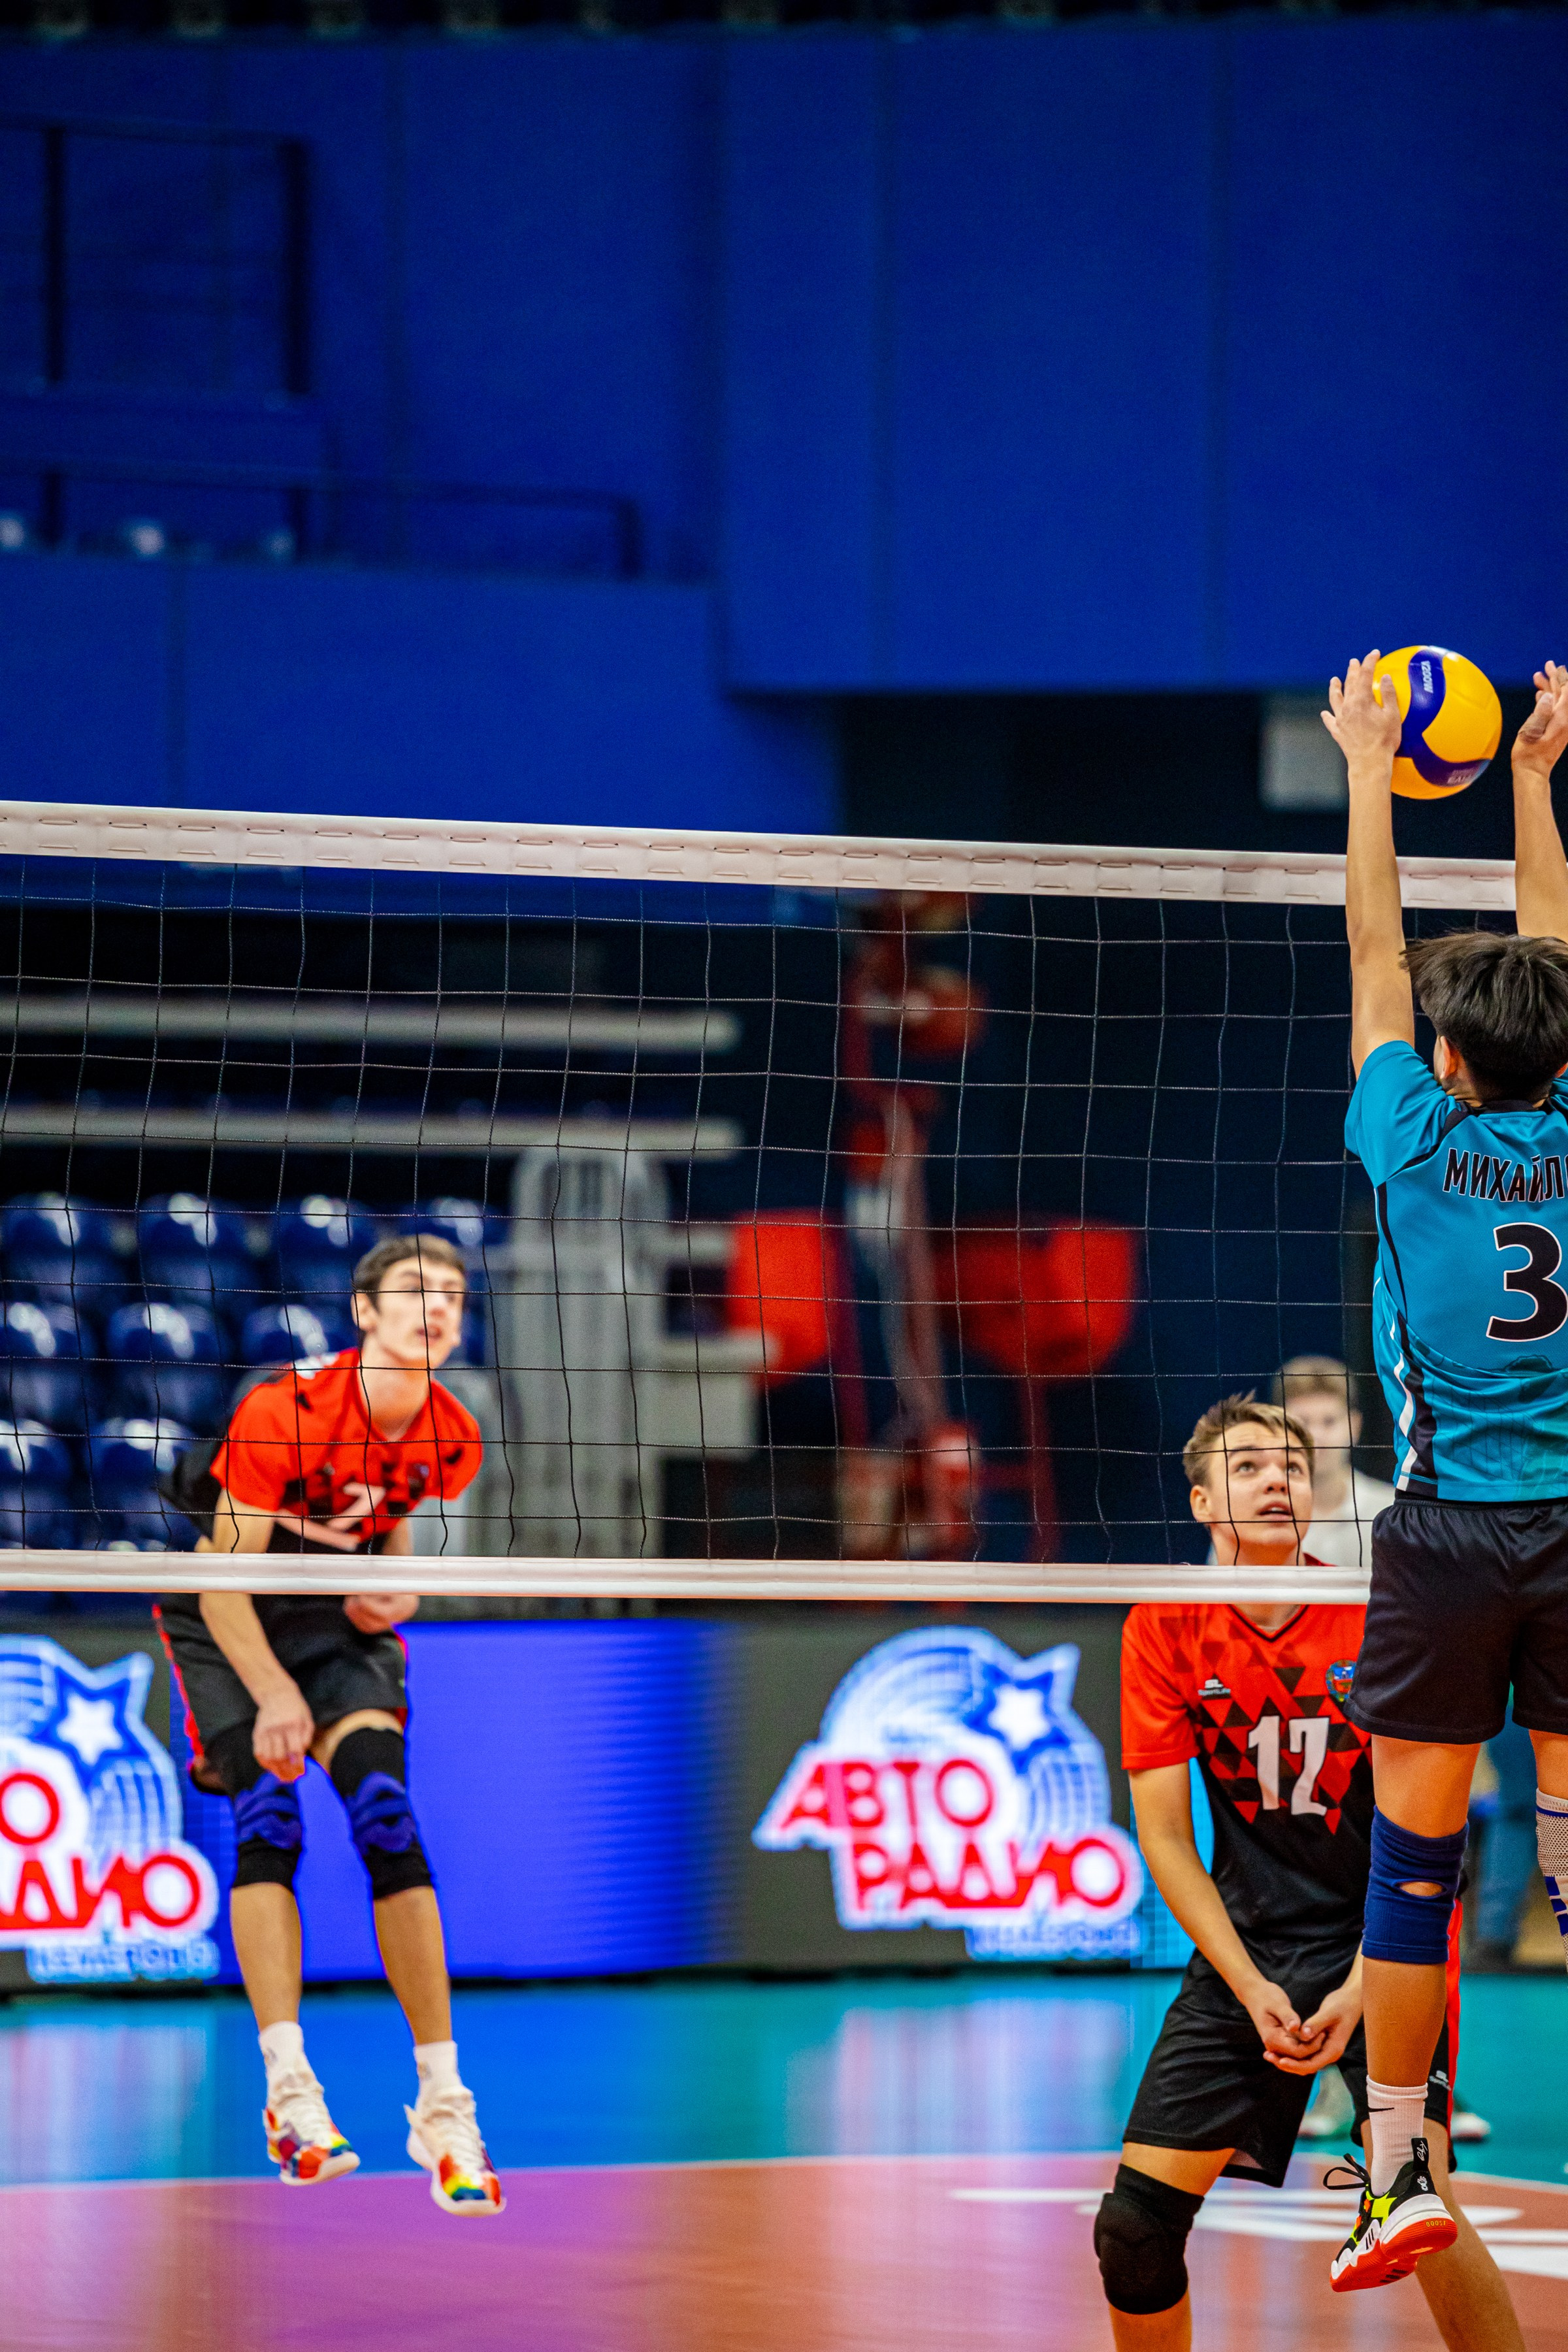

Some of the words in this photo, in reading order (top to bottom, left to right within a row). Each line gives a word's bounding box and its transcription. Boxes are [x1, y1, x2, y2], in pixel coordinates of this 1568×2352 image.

[1420, 661, 1433, 693] V200W
[1443, 1147, 1568, 1203] МИХАЙЛ
[1486, 1222, 1568, 1342] 3
[779, 1759, 996, 1831] АВТО
[1248, 1715, 1330, 1816] 12
[0, 1854, 201, 1929] ДИО
[851, 1837, 1126, 1912] РАДИО
